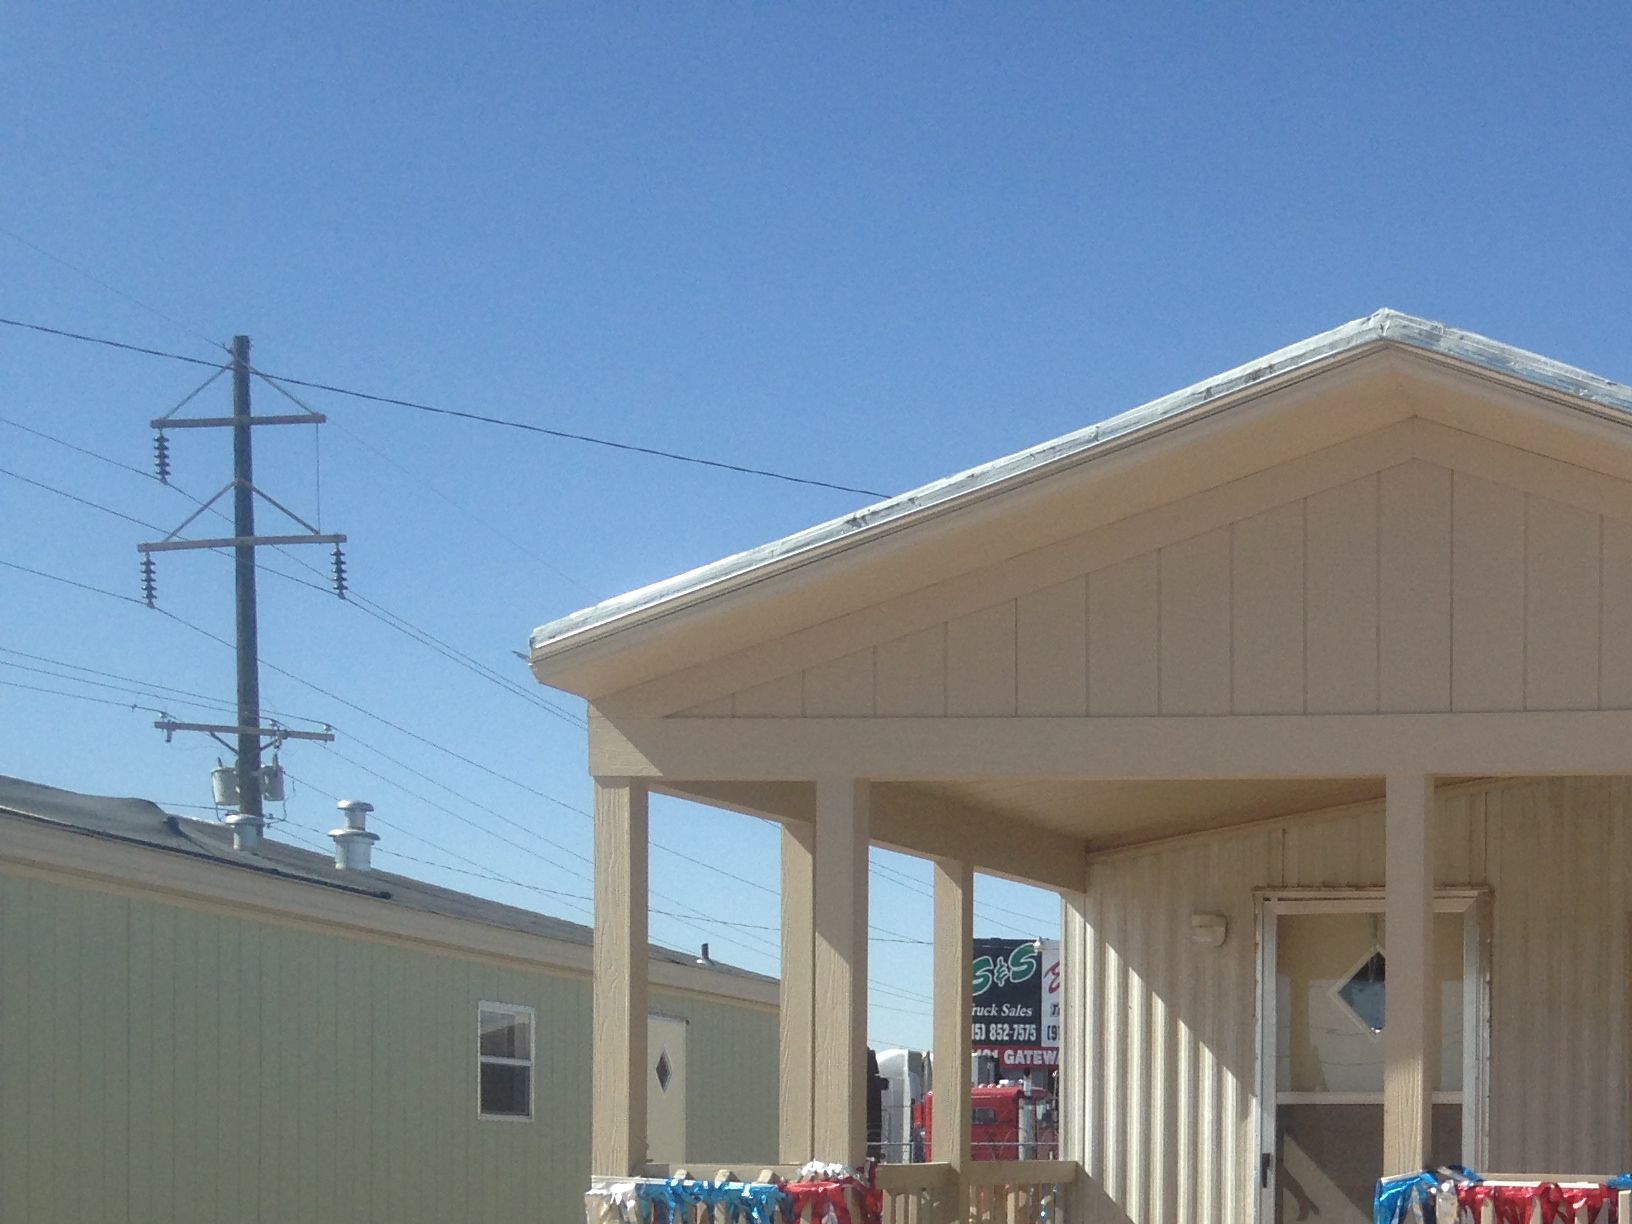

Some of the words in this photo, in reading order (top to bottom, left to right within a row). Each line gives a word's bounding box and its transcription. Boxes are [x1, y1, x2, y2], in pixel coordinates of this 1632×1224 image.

[972, 1003, 998, 1017] ruck
[1001, 1003, 1033, 1017] Sales
[989, 1023, 1037, 1041] 852-7575
[1003, 1049, 1059, 1065] GATEW
